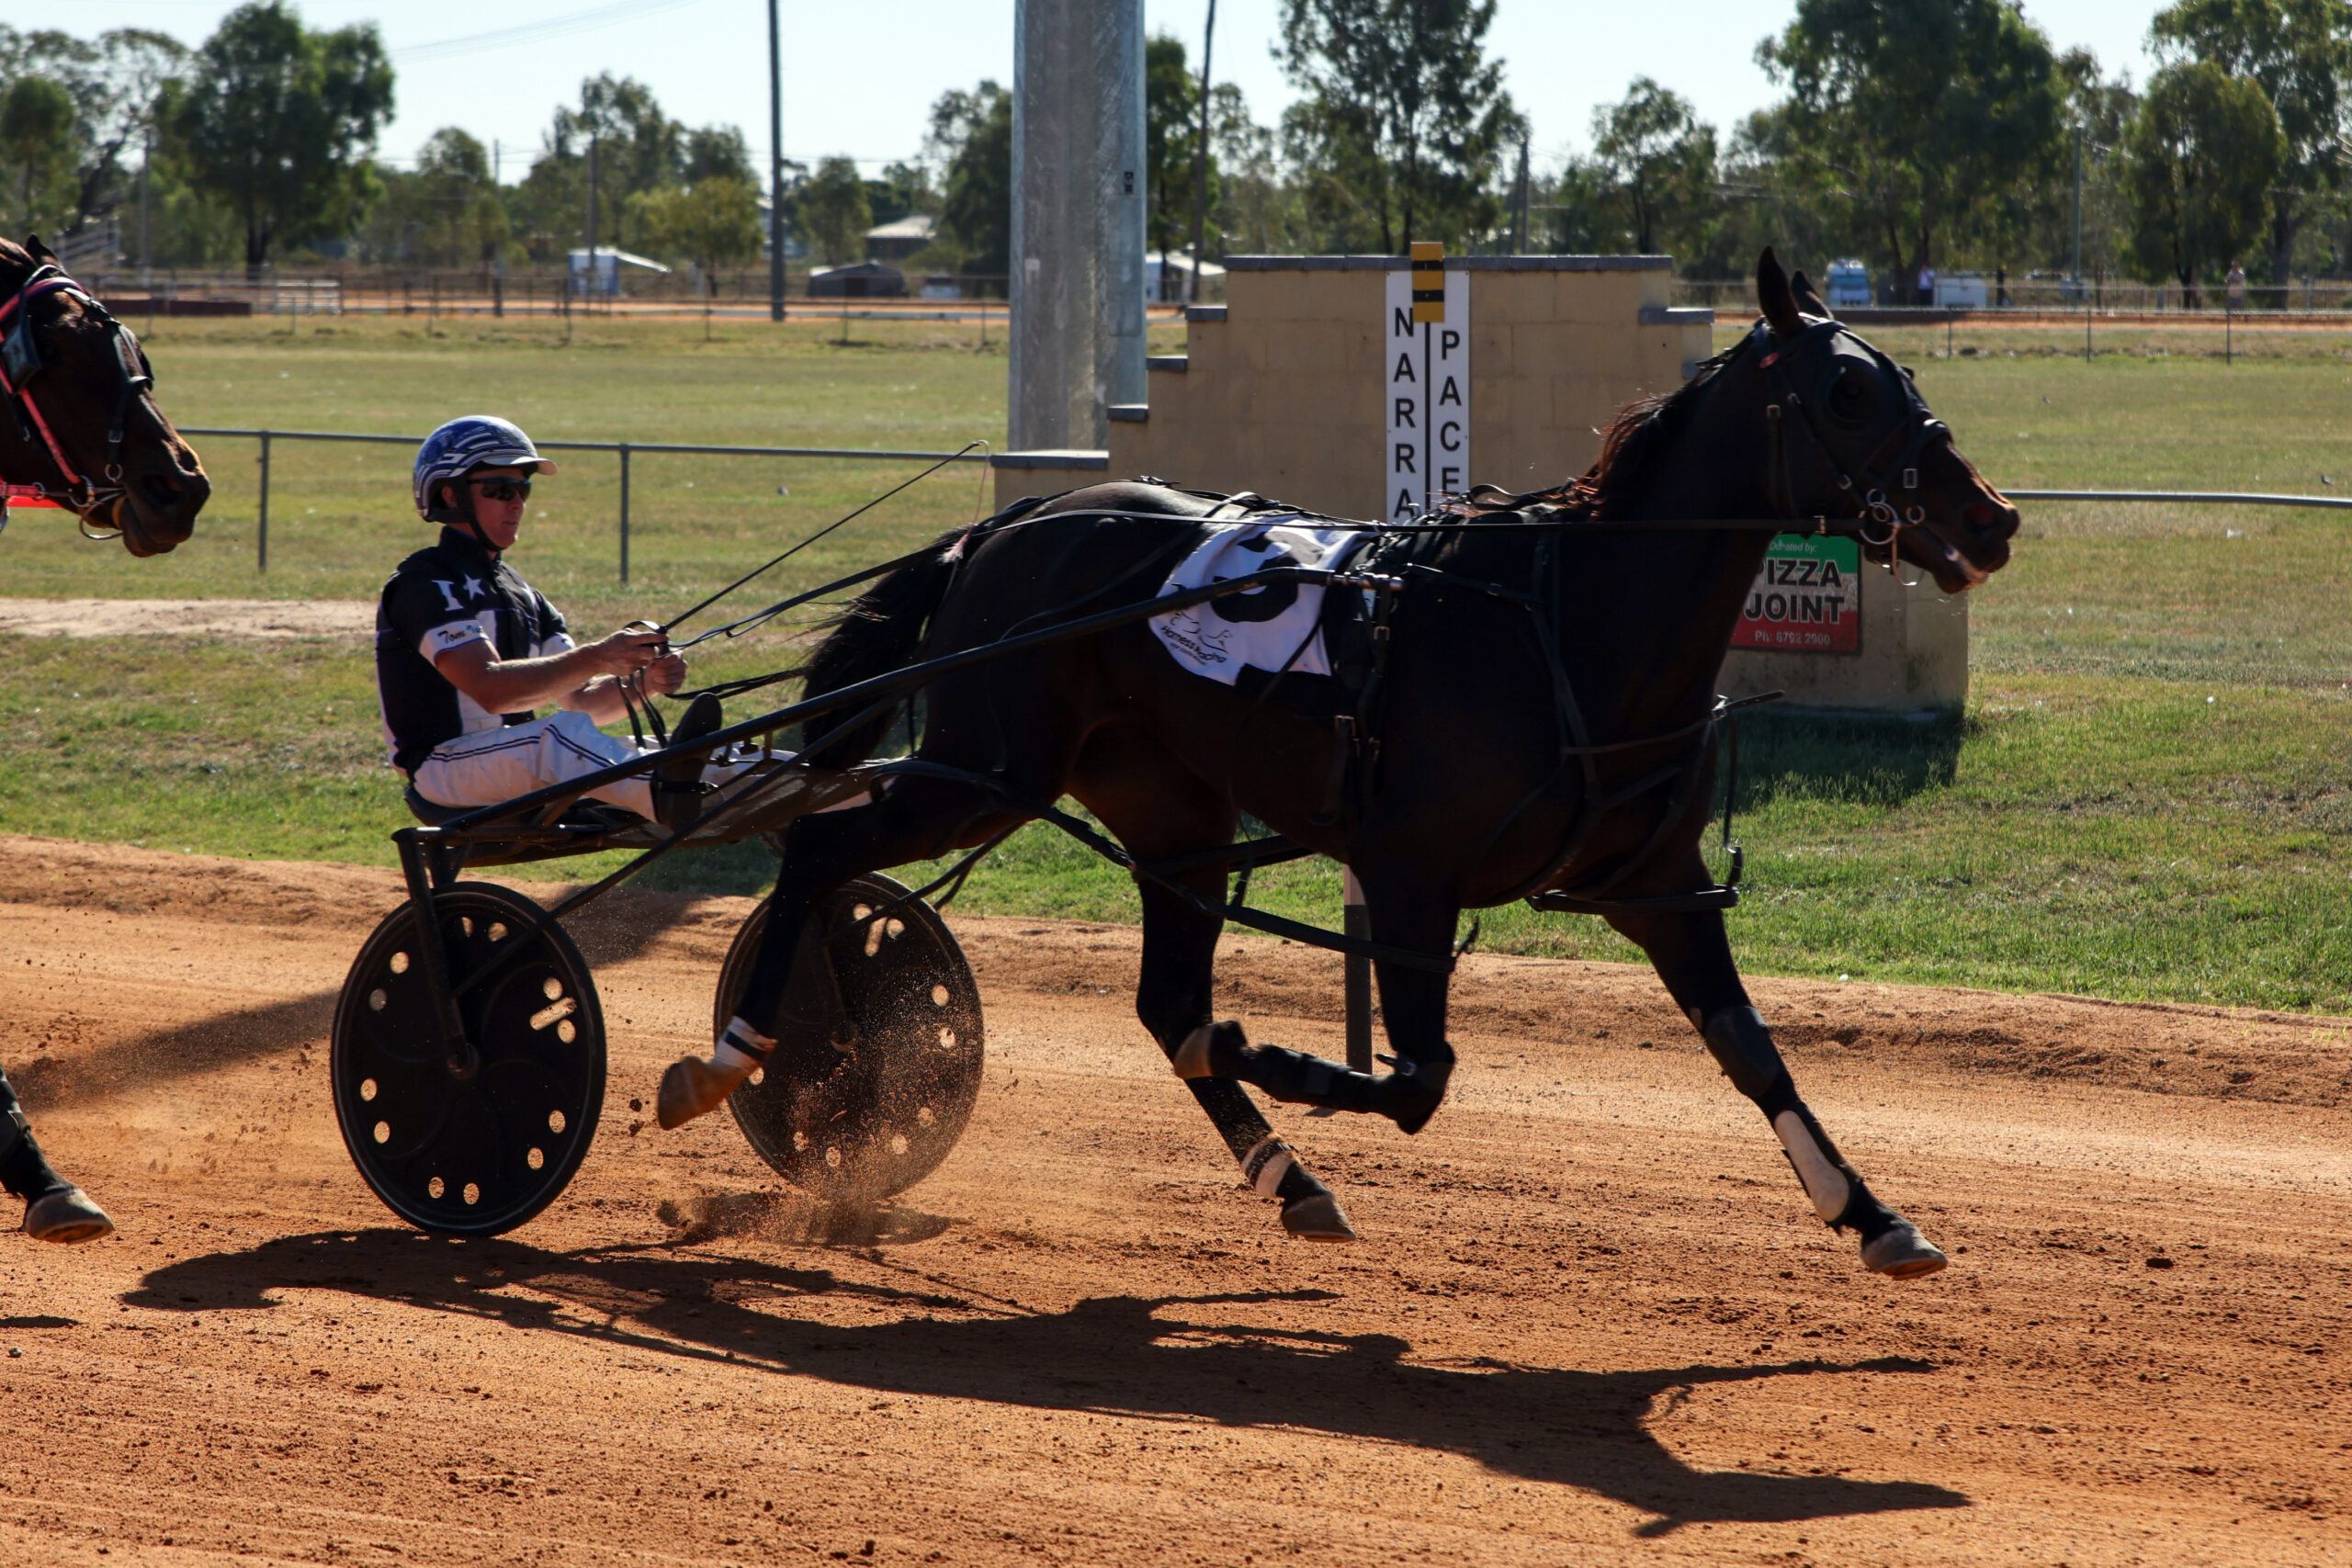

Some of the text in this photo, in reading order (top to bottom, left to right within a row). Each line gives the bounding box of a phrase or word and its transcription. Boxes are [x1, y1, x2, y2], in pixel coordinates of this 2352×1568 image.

[1805, 542, 1817, 553] by:
[1758, 557, 1843, 588] IZZA
[1744, 592, 1845, 625] JOINT
[1755, 630, 1772, 642] Ph:
